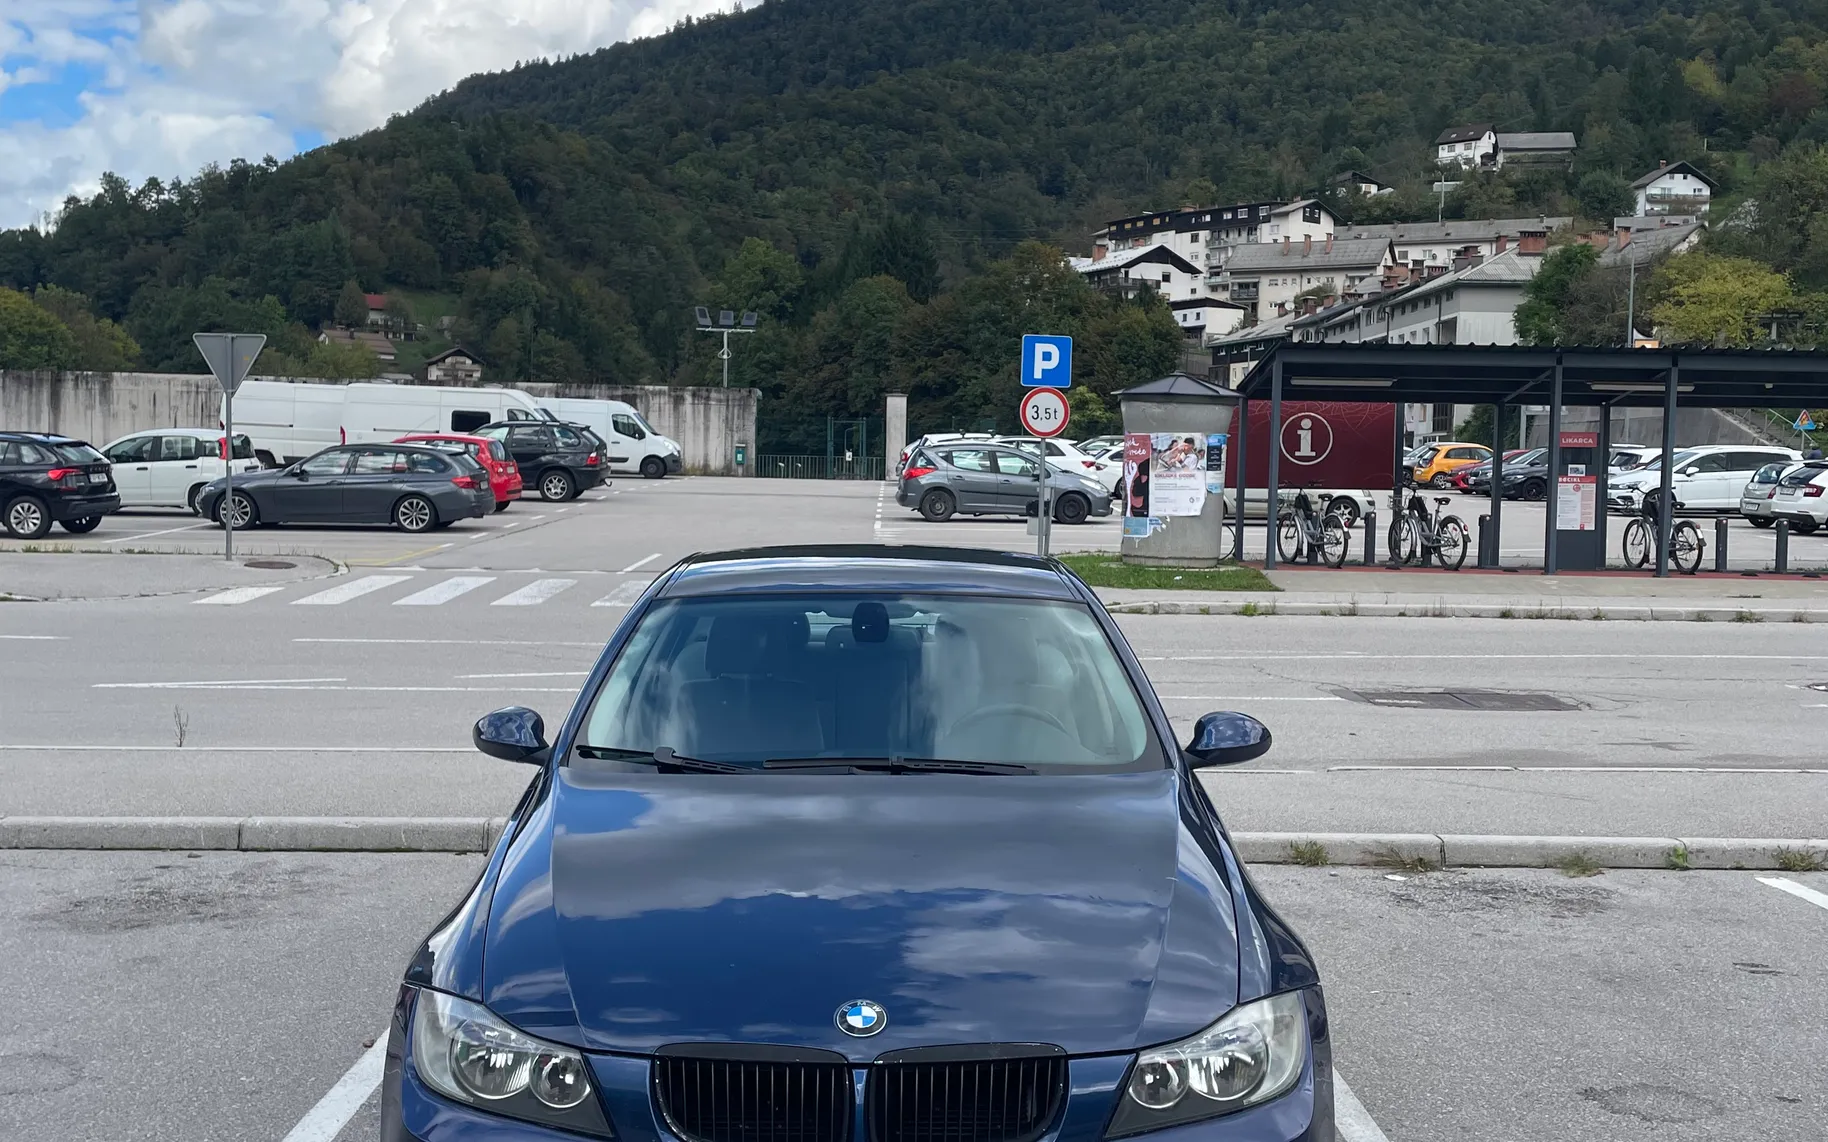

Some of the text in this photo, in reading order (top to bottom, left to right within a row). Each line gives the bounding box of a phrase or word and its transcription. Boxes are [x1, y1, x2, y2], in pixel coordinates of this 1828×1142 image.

[1033, 342, 1060, 379] P
[1031, 404, 1058, 421] 3,5 t
[842, 1001, 882, 1012] BMW
